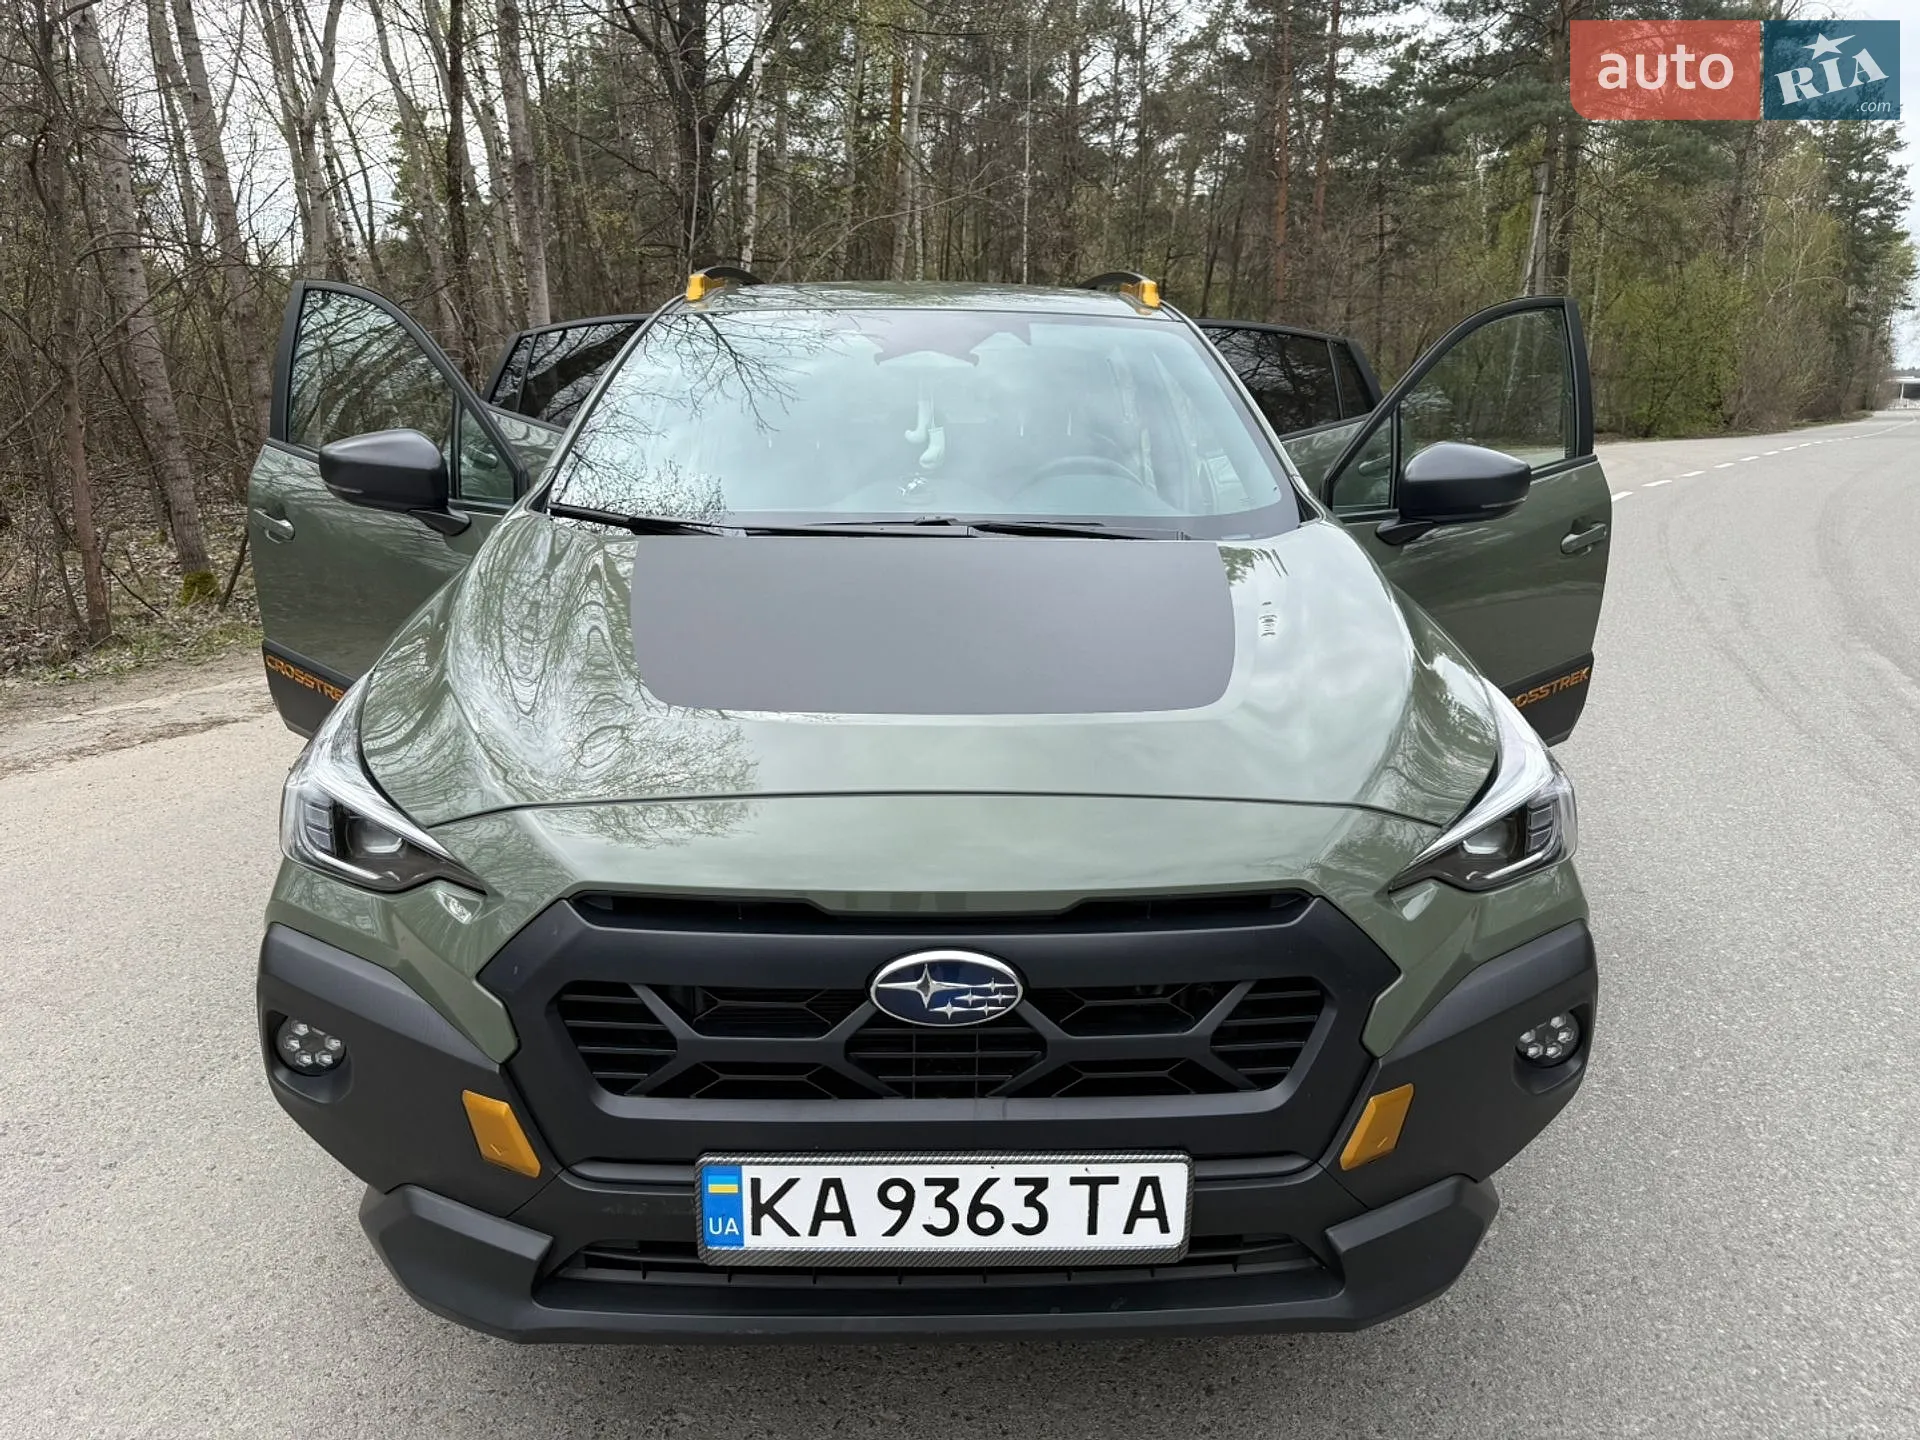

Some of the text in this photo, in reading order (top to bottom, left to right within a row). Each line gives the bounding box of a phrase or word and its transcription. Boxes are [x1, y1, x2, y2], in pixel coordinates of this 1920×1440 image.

[708, 1217, 740, 1235] UA
[750, 1176, 1171, 1237] KA 9363 TA
